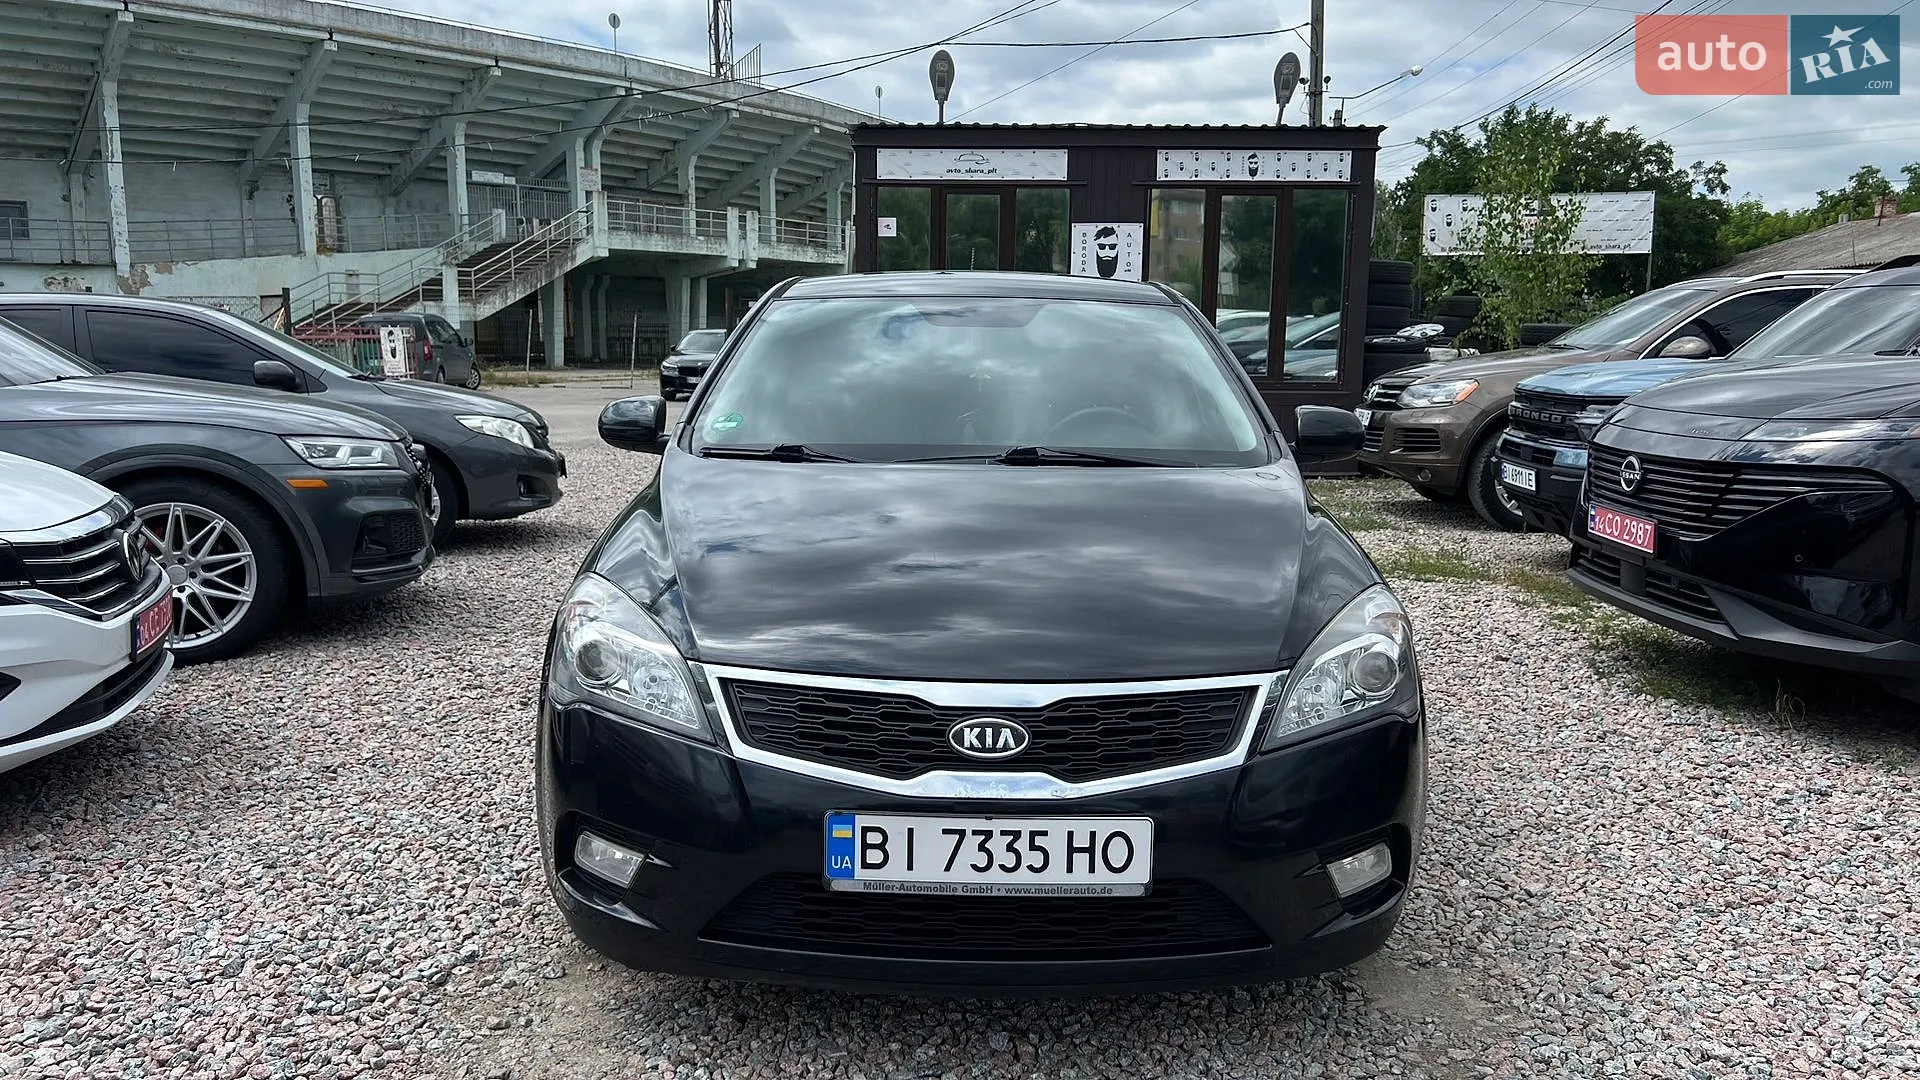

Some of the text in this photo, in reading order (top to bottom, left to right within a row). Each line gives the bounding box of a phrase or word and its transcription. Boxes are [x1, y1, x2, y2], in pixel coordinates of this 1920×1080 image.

[1623, 518, 1652, 547] 2987
[963, 727, 1016, 749] KIA
[860, 825, 1135, 875] BI 7335 HO
[831, 855, 852, 870] UA
[863, 881, 1114, 895] Müller-Automobile GmbH www.muellerauto.de
